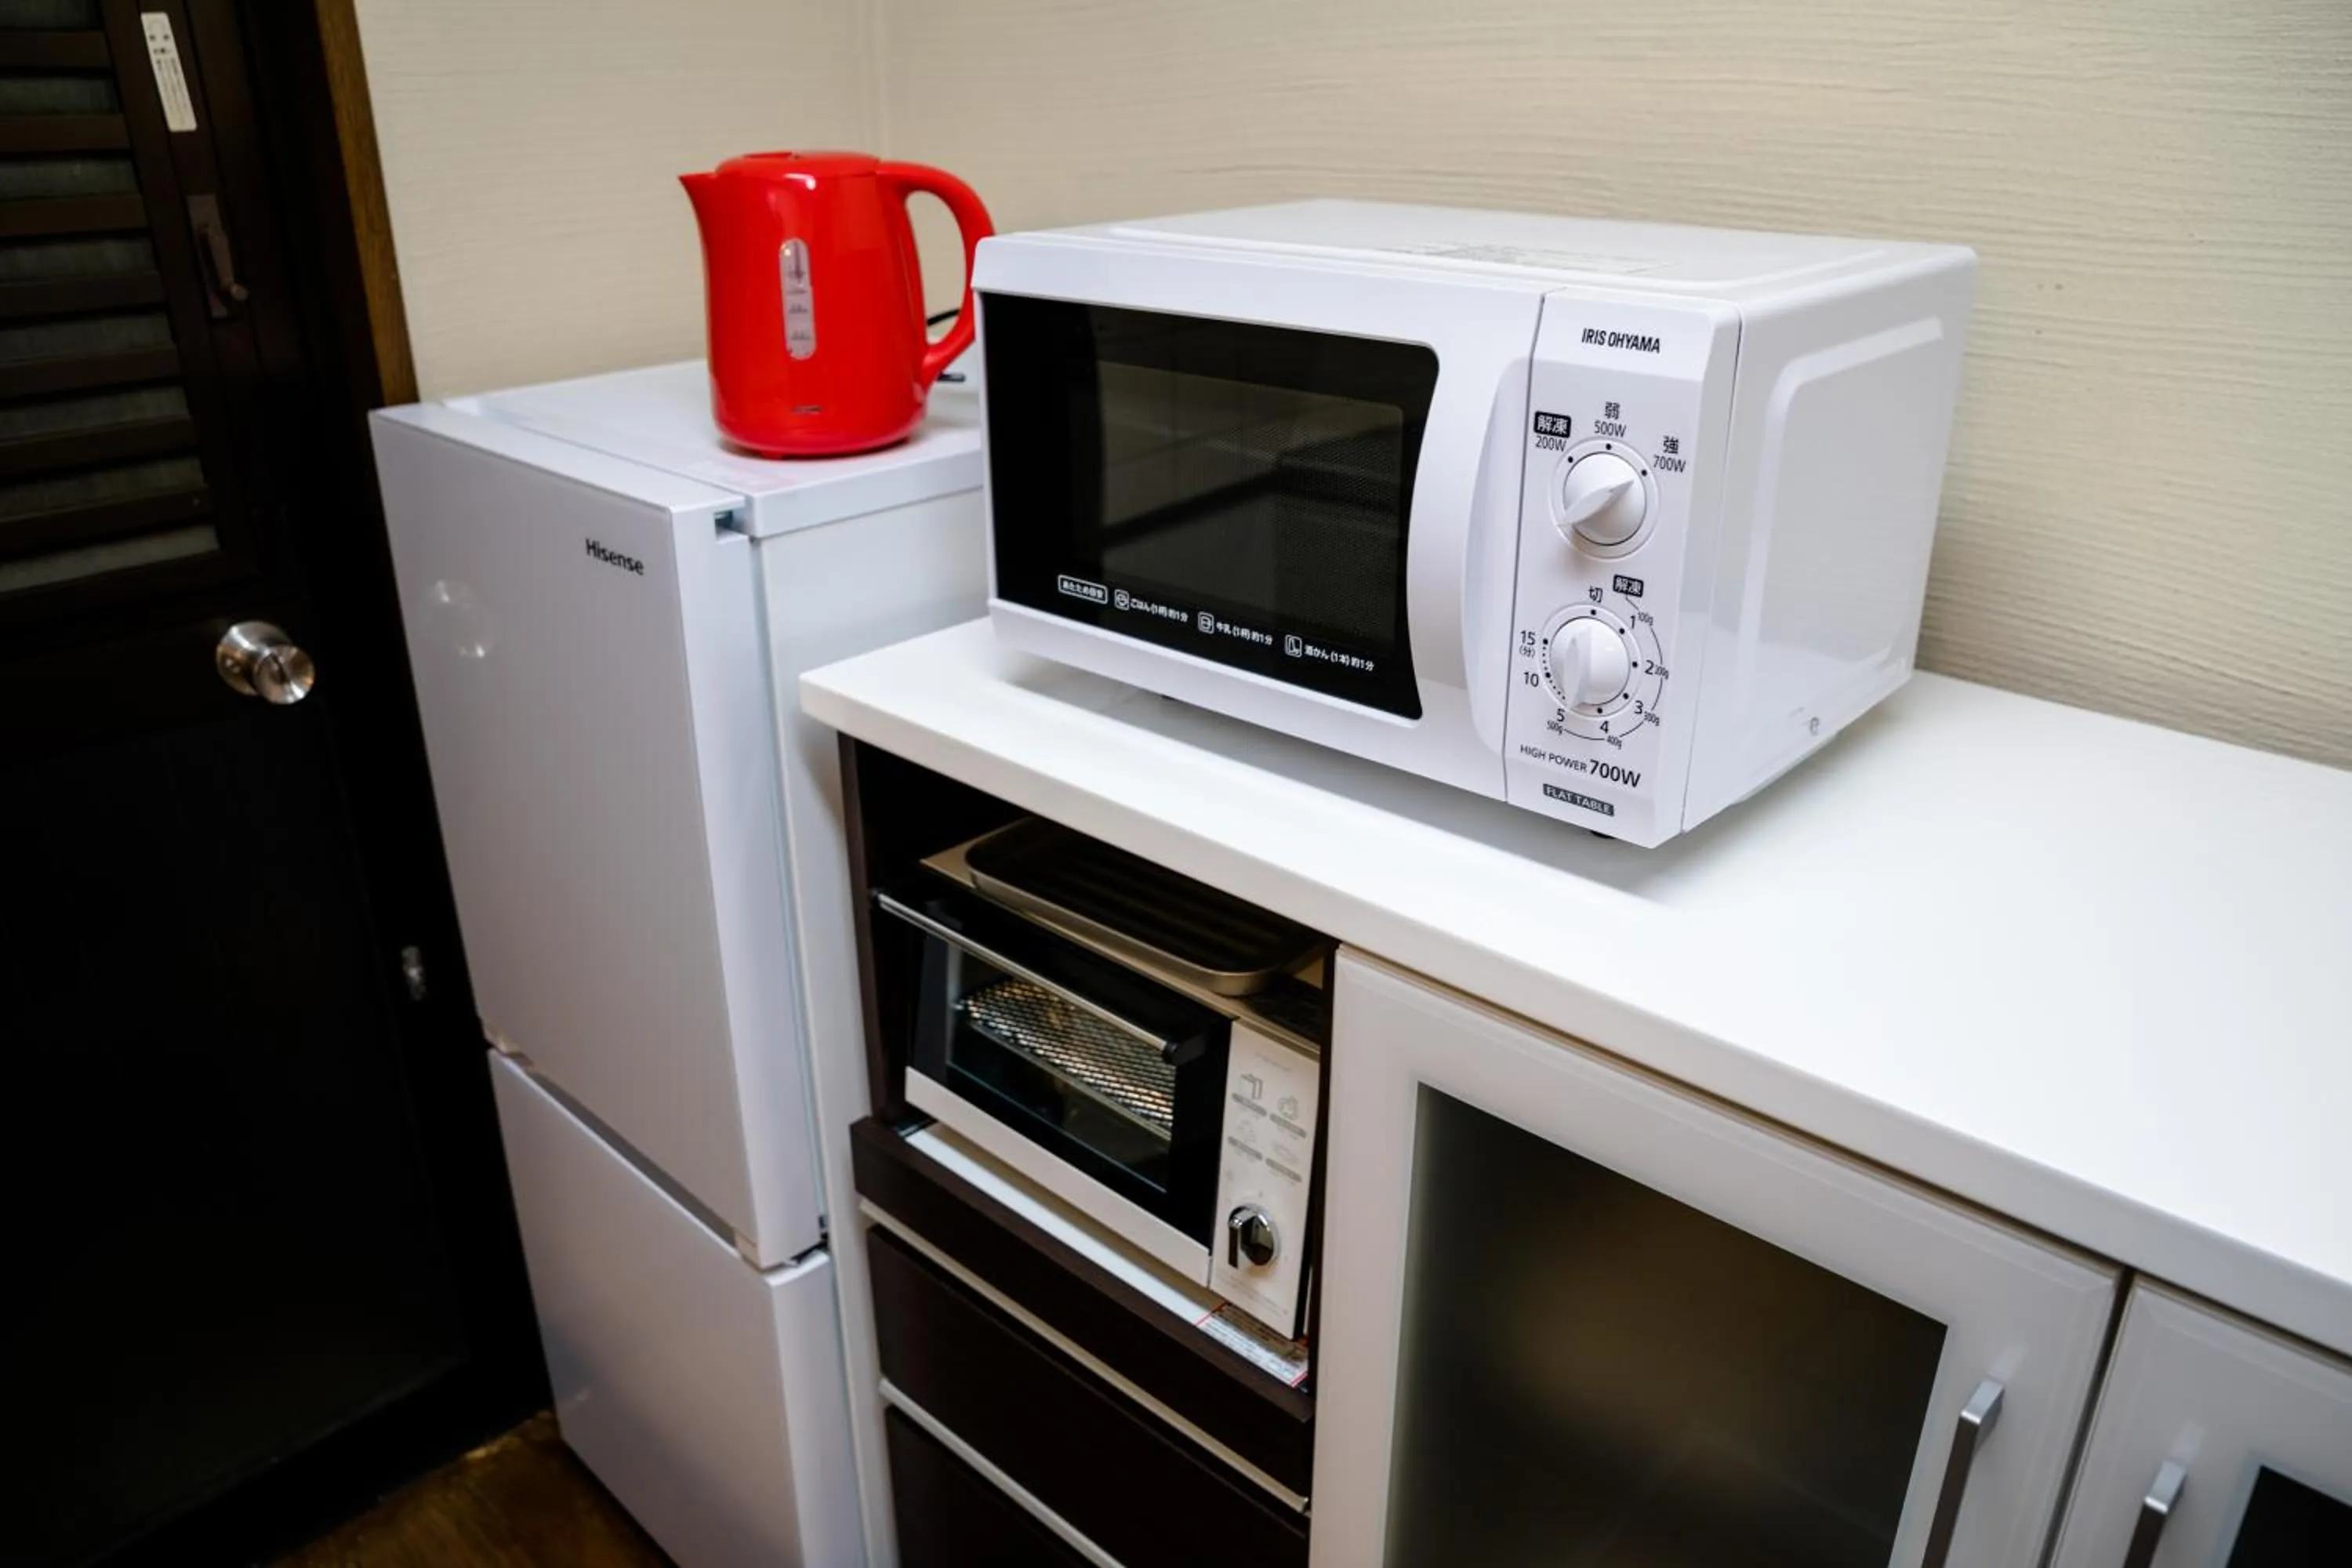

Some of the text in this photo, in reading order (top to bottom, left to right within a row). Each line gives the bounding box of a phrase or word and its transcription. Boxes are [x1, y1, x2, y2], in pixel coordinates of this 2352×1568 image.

[1581, 328, 1661, 354] IRIS OHYAMA
[1604, 401, 1621, 419] 弱
[1537, 414, 1569, 435] 解凍
[1594, 420, 1627, 437] 500W
[1535, 435, 1567, 452] 200W
[1663, 436, 1679, 454] 強
[1653, 456, 1686, 473] 700W
[585, 537, 644, 576] Hisense
[1614, 576, 1642, 595] 解凍
[1588, 586, 1603, 603] 切
[1630, 615, 1636, 630] 1
[1519, 630, 1536, 645] 15
[1644, 659, 1654, 675] 2
[1523, 671, 1539, 688] 10
[1556, 708, 1565, 722] 5
[1634, 700, 1644, 714] 3
[1599, 720, 1610, 734] 4
[1519, 744, 1642, 789] HIGH POWER 700W
[1545, 786, 1612, 815] FLAT TABLE
